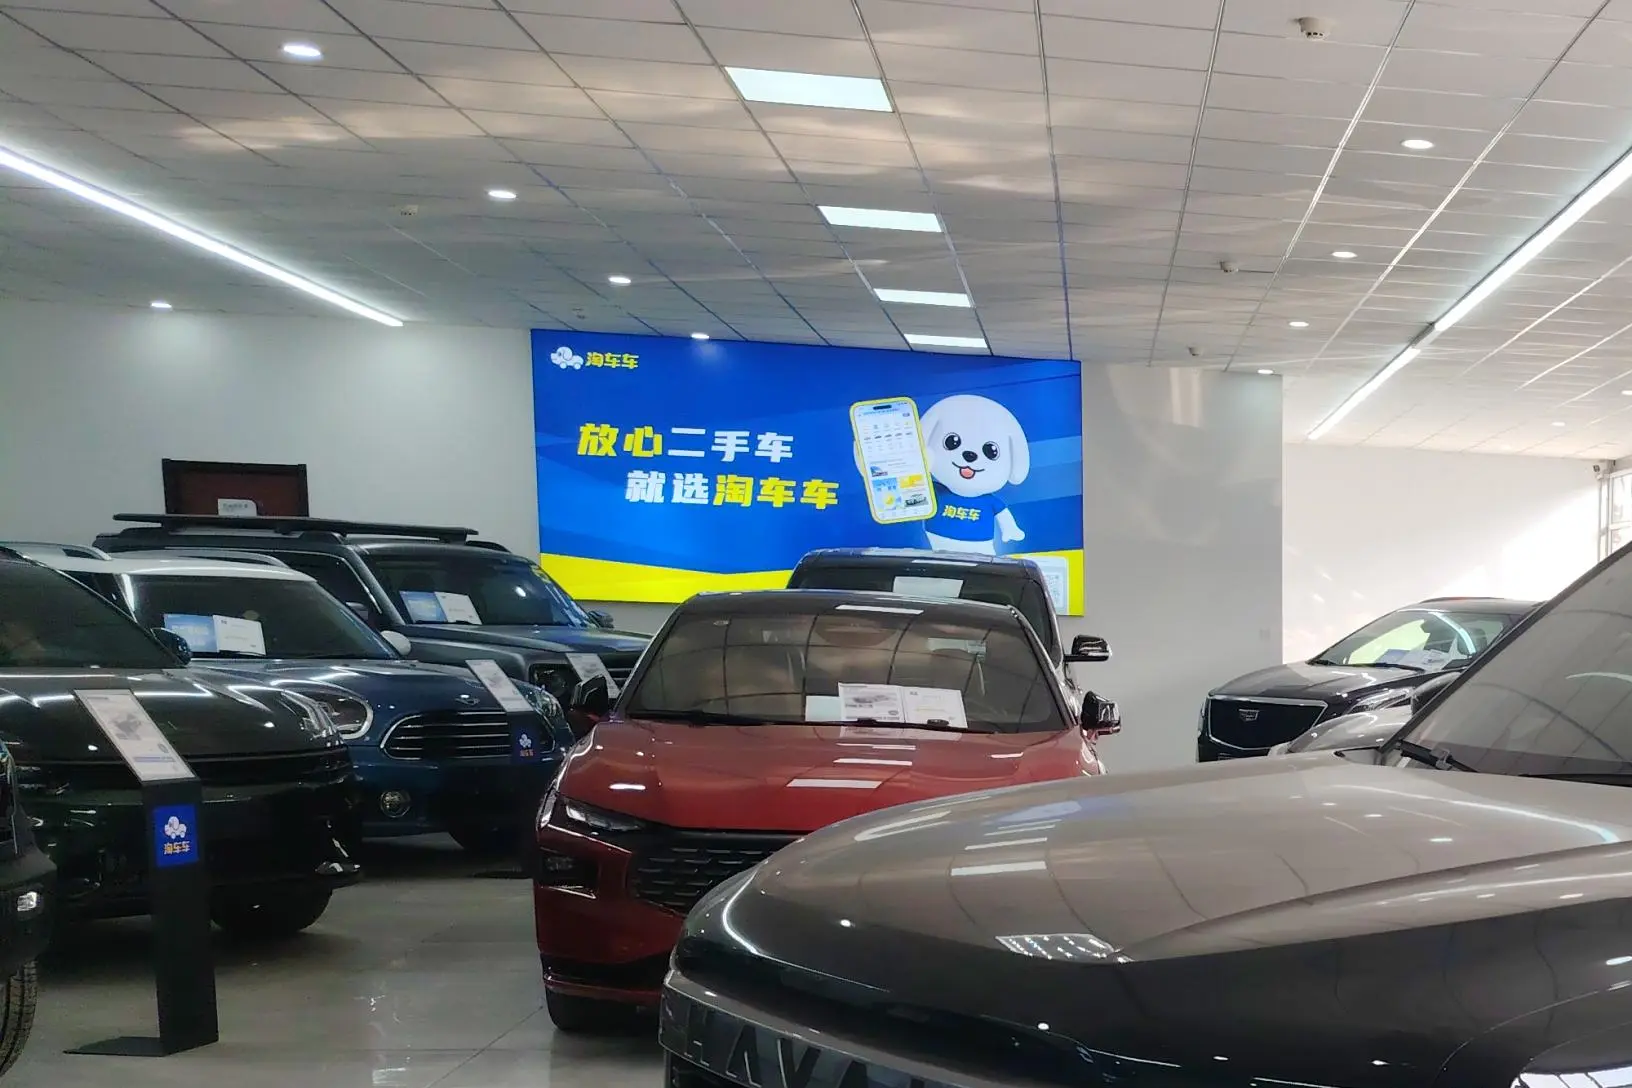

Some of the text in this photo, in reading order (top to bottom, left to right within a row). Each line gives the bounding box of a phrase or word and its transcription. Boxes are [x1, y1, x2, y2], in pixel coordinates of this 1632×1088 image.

[585, 351, 639, 369] 淘车车
[577, 423, 794, 463] 放心二手车
[624, 469, 839, 509] 就选淘车车
[941, 505, 981, 521] 淘车车
